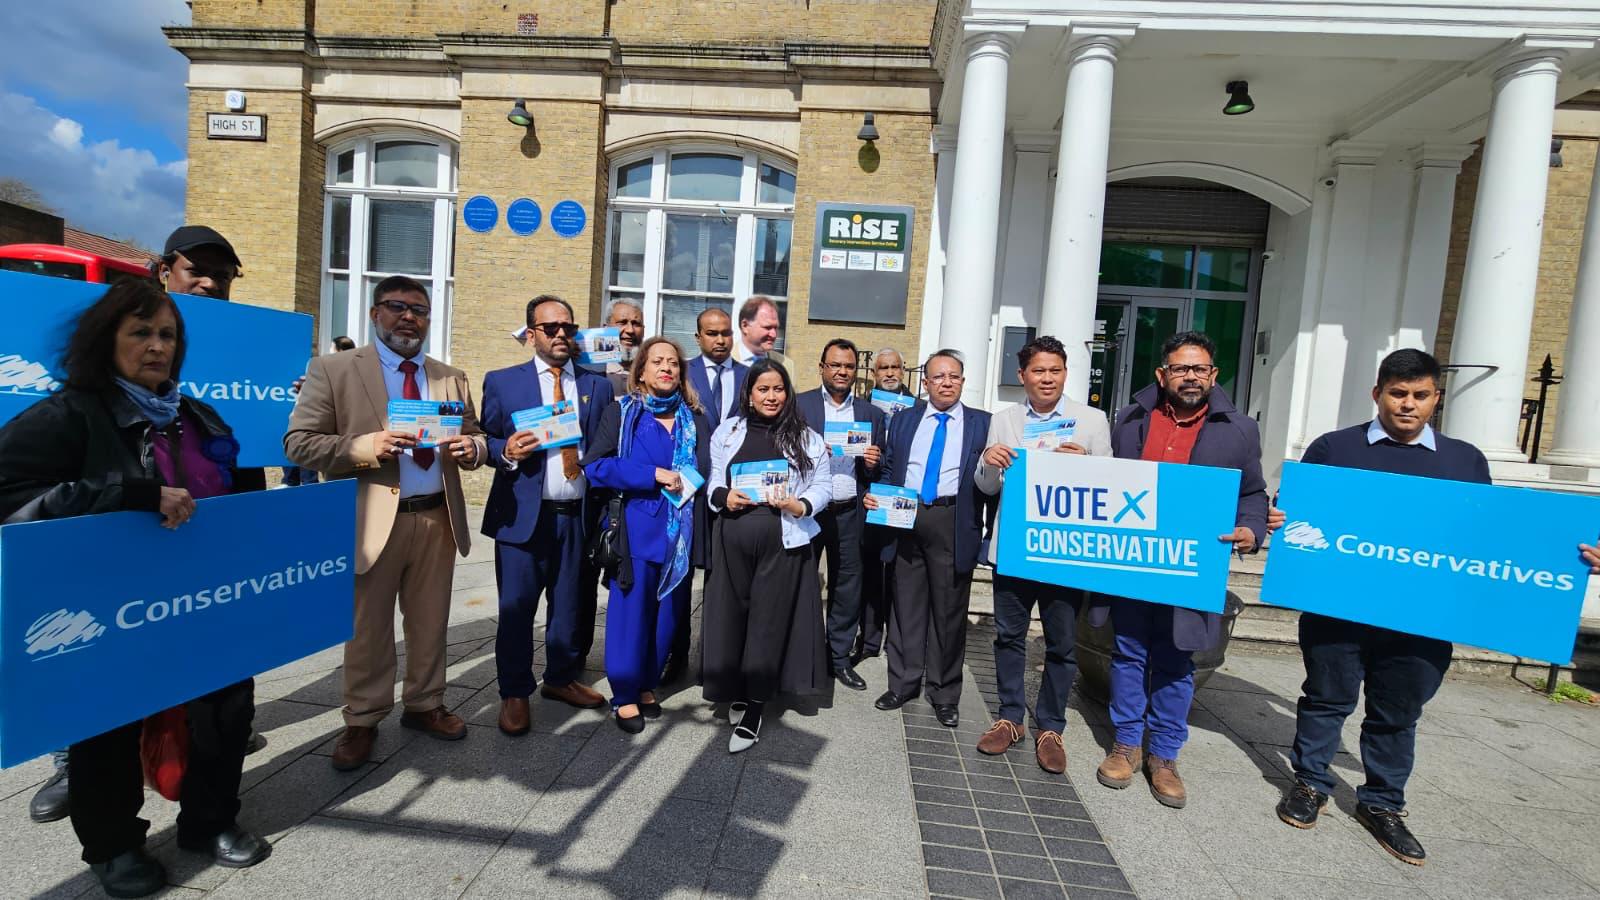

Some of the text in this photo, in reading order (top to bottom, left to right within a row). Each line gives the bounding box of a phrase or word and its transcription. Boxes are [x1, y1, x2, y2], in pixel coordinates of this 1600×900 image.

[212, 119, 257, 131] HIGH ST.
[177, 379, 299, 402] rvatives
[1035, 484, 1109, 521] VOTE
[1026, 527, 1199, 567] CONSERVATIVE
[1335, 534, 1576, 592] Conservatives
[115, 555, 348, 630] Conservatives
